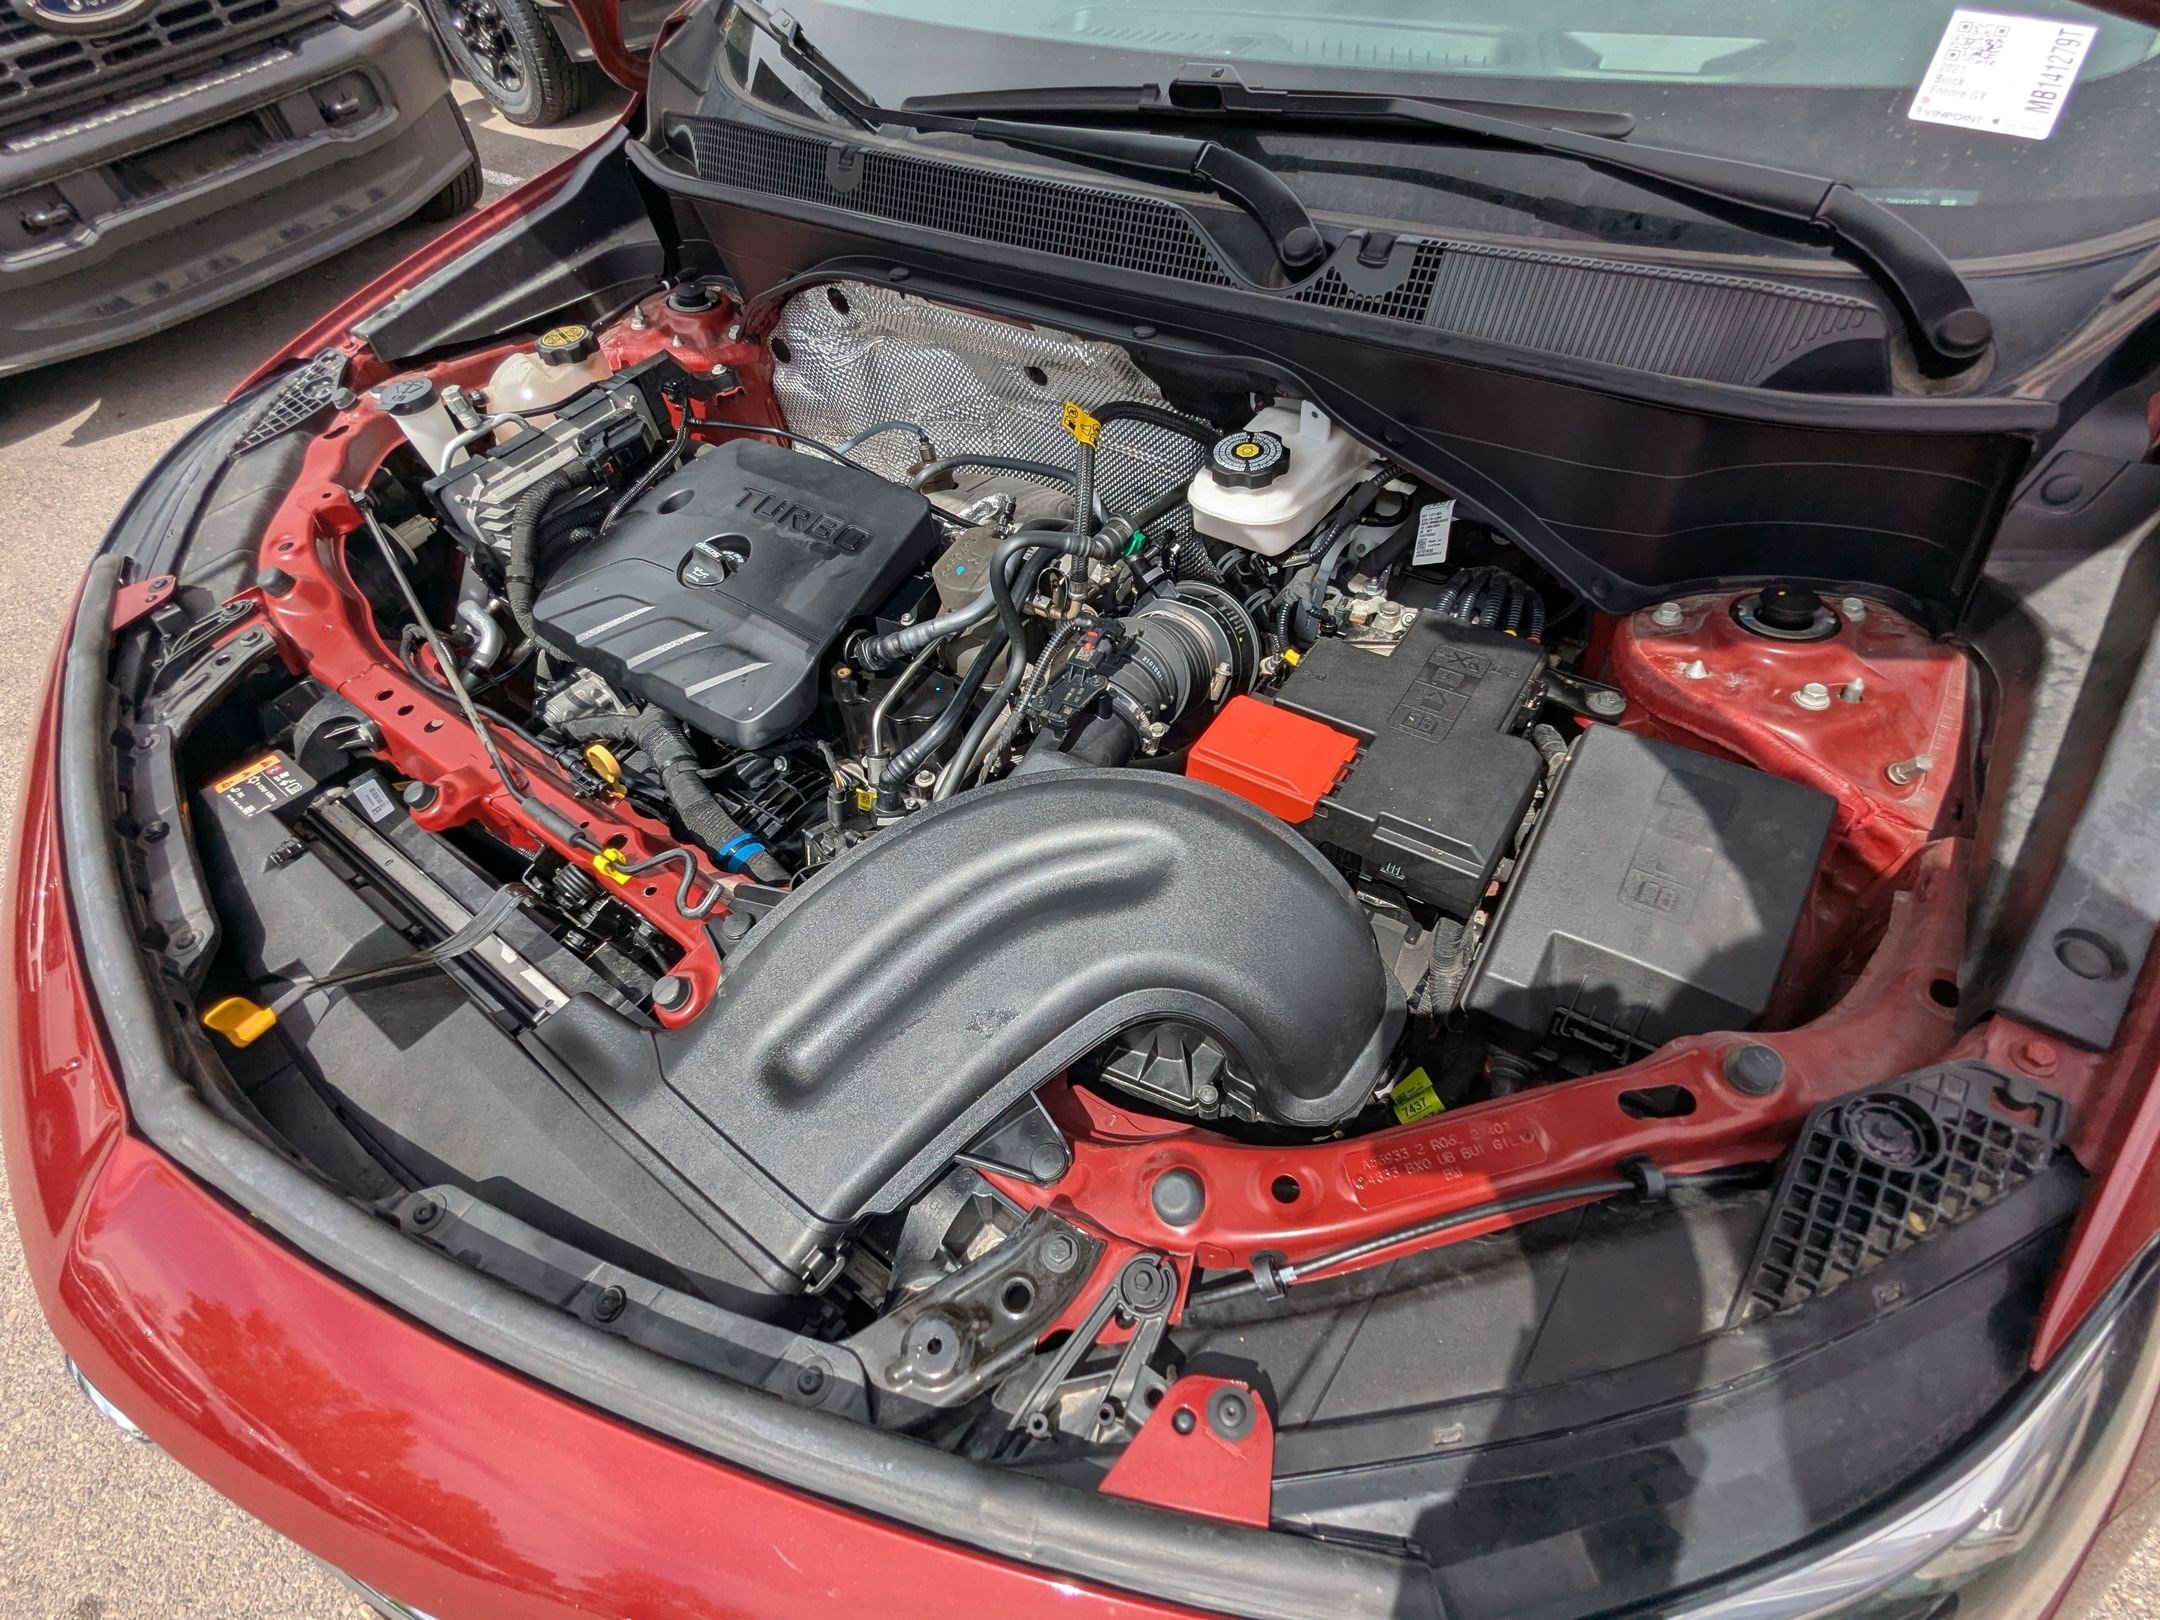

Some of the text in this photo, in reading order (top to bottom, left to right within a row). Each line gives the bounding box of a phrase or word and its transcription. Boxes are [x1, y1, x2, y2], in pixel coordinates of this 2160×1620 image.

[1939, 62, 1966, 74] 2021
[2024, 27, 2086, 114] MB141279T
[1934, 74, 1965, 86] Buick
[1929, 85, 1988, 101] Encore GX
[1924, 108, 1984, 124] VINPOINT
[736, 485, 874, 553] TURBO
[1402, 1097, 1426, 1116] 7437
